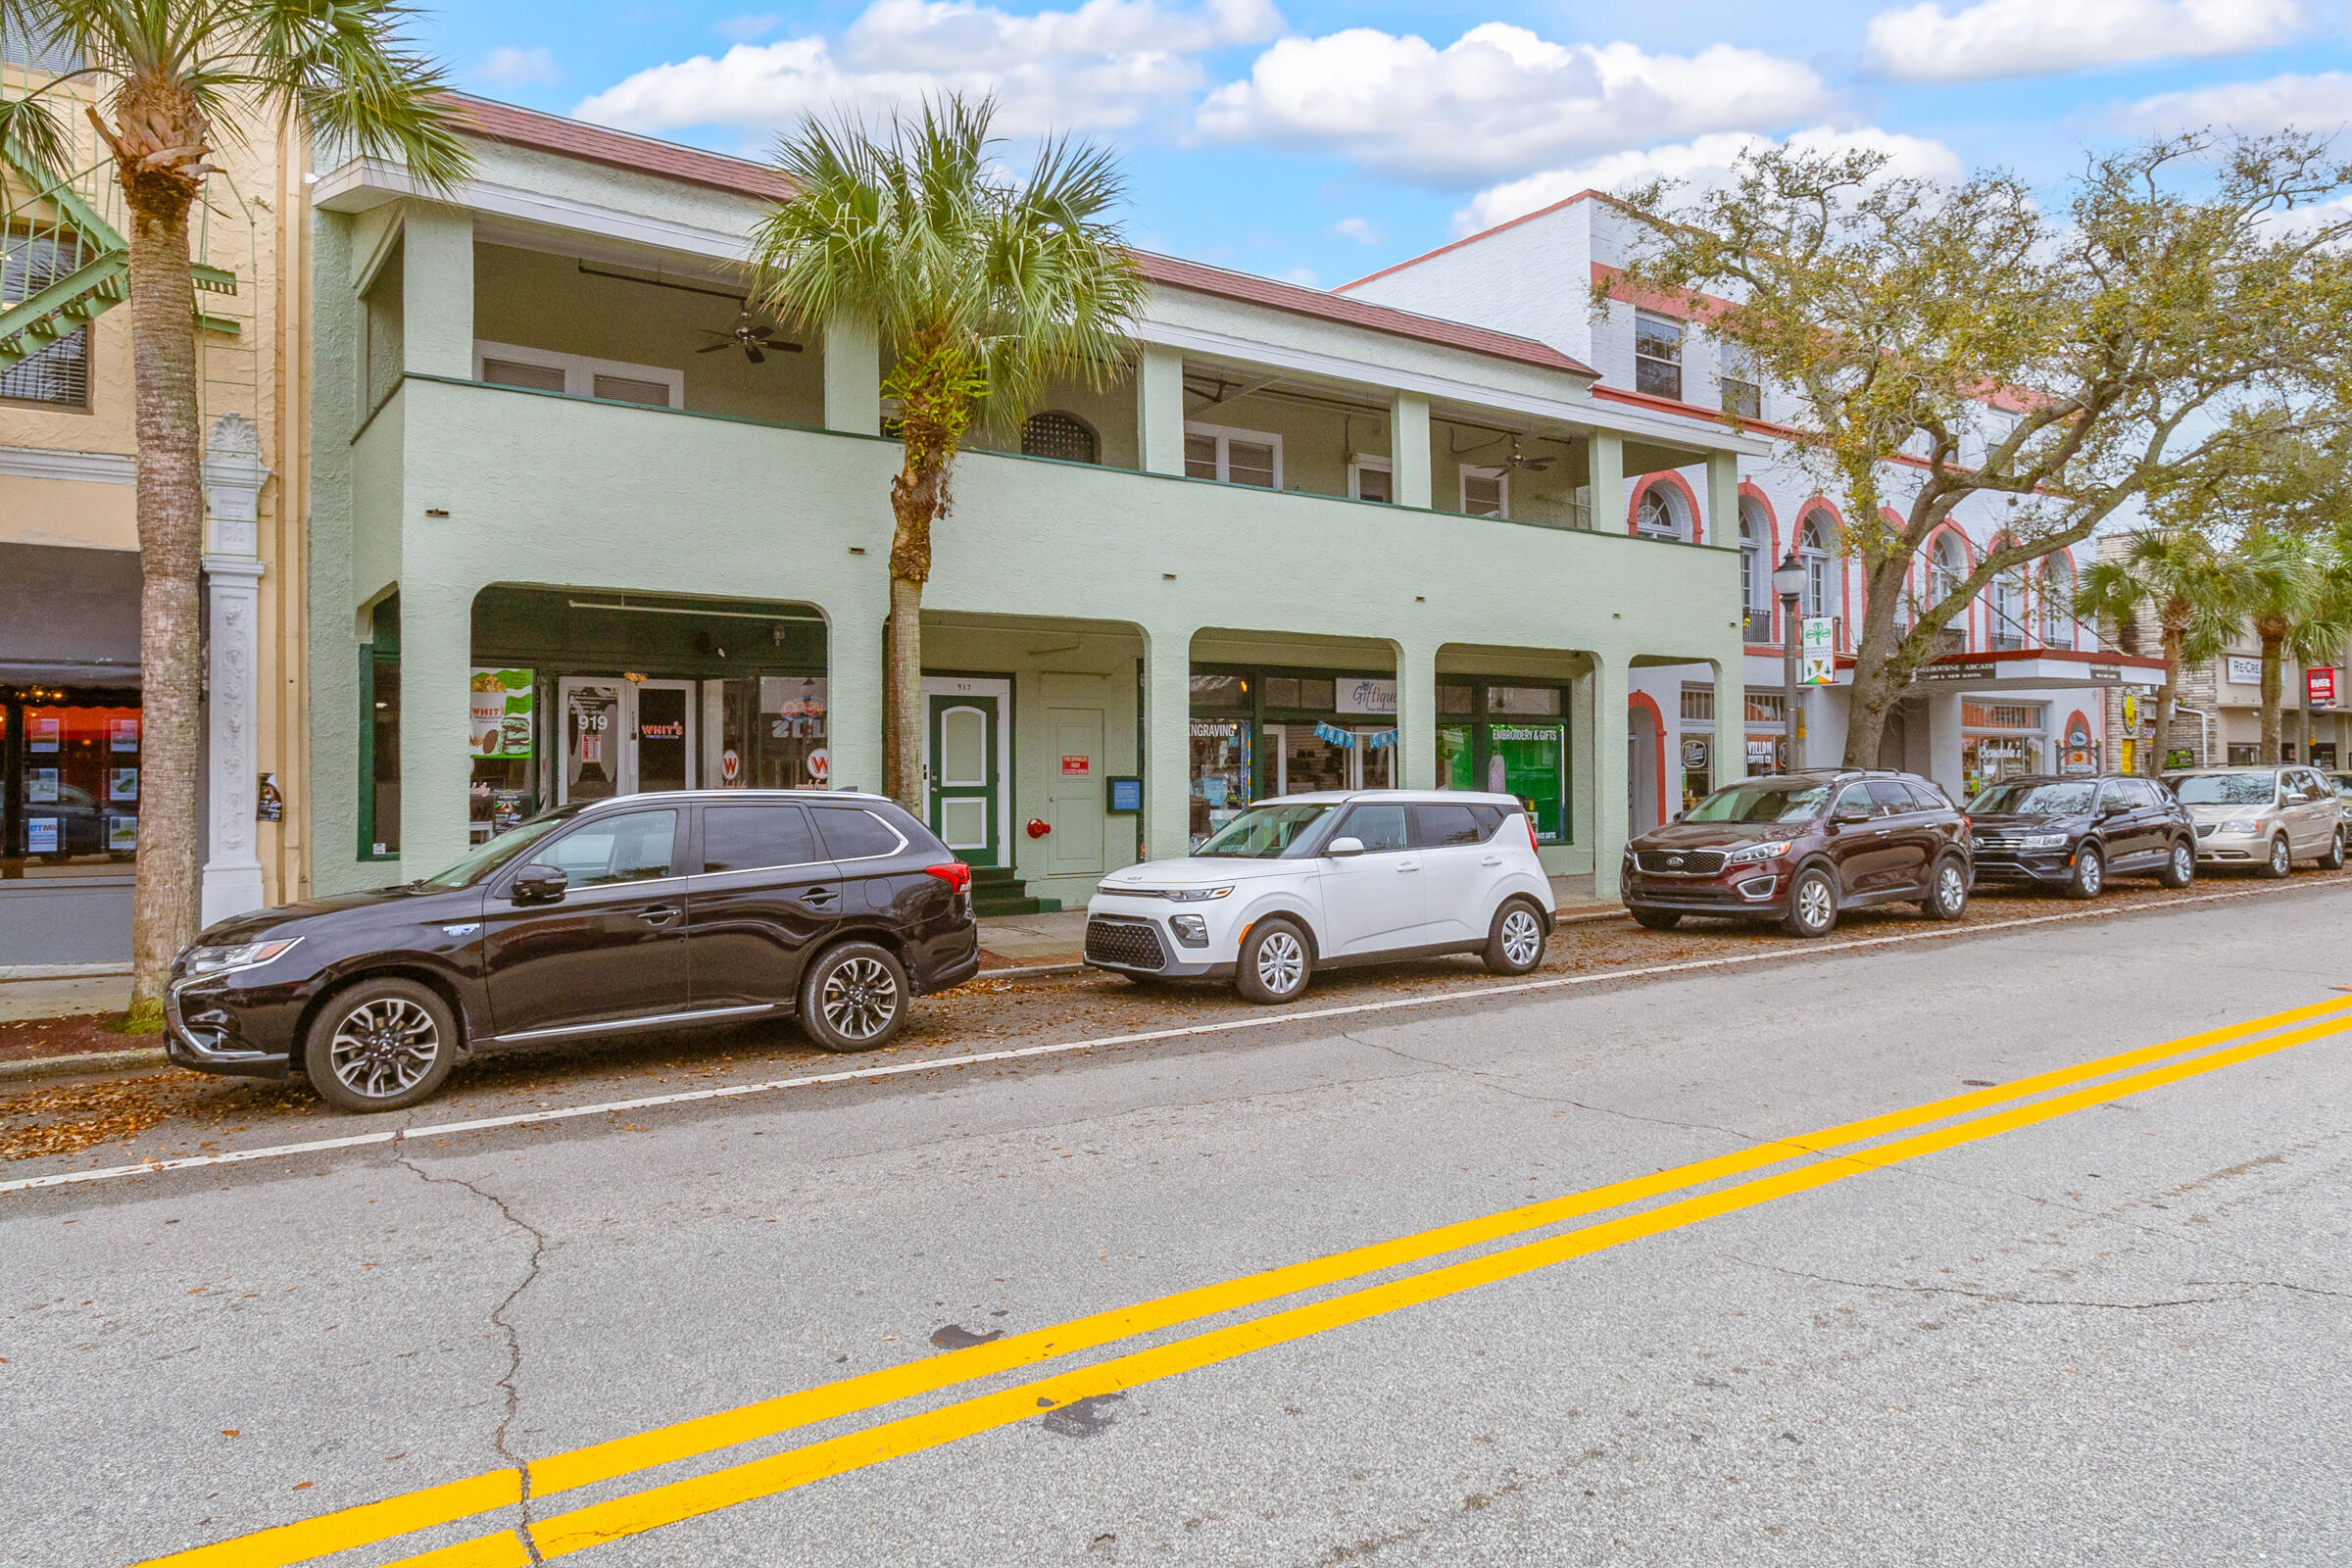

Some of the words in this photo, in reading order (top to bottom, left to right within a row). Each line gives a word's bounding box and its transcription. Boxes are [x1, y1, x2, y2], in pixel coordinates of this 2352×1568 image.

[783, 701, 824, 717] OPEN
[578, 715, 608, 730] 919
[641, 721, 683, 735] WHIT'S
[1189, 723, 1235, 736] NGRAVING
[1493, 729, 1533, 740] EMBROIDERY
[1533, 730, 1539, 740] &
[1540, 730, 1556, 740] GIFTS
[1747, 741, 1772, 754] VILLON
[723, 757, 737, 775] W
[810, 756, 828, 774] W
[1747, 755, 1764, 763] COFFEE
